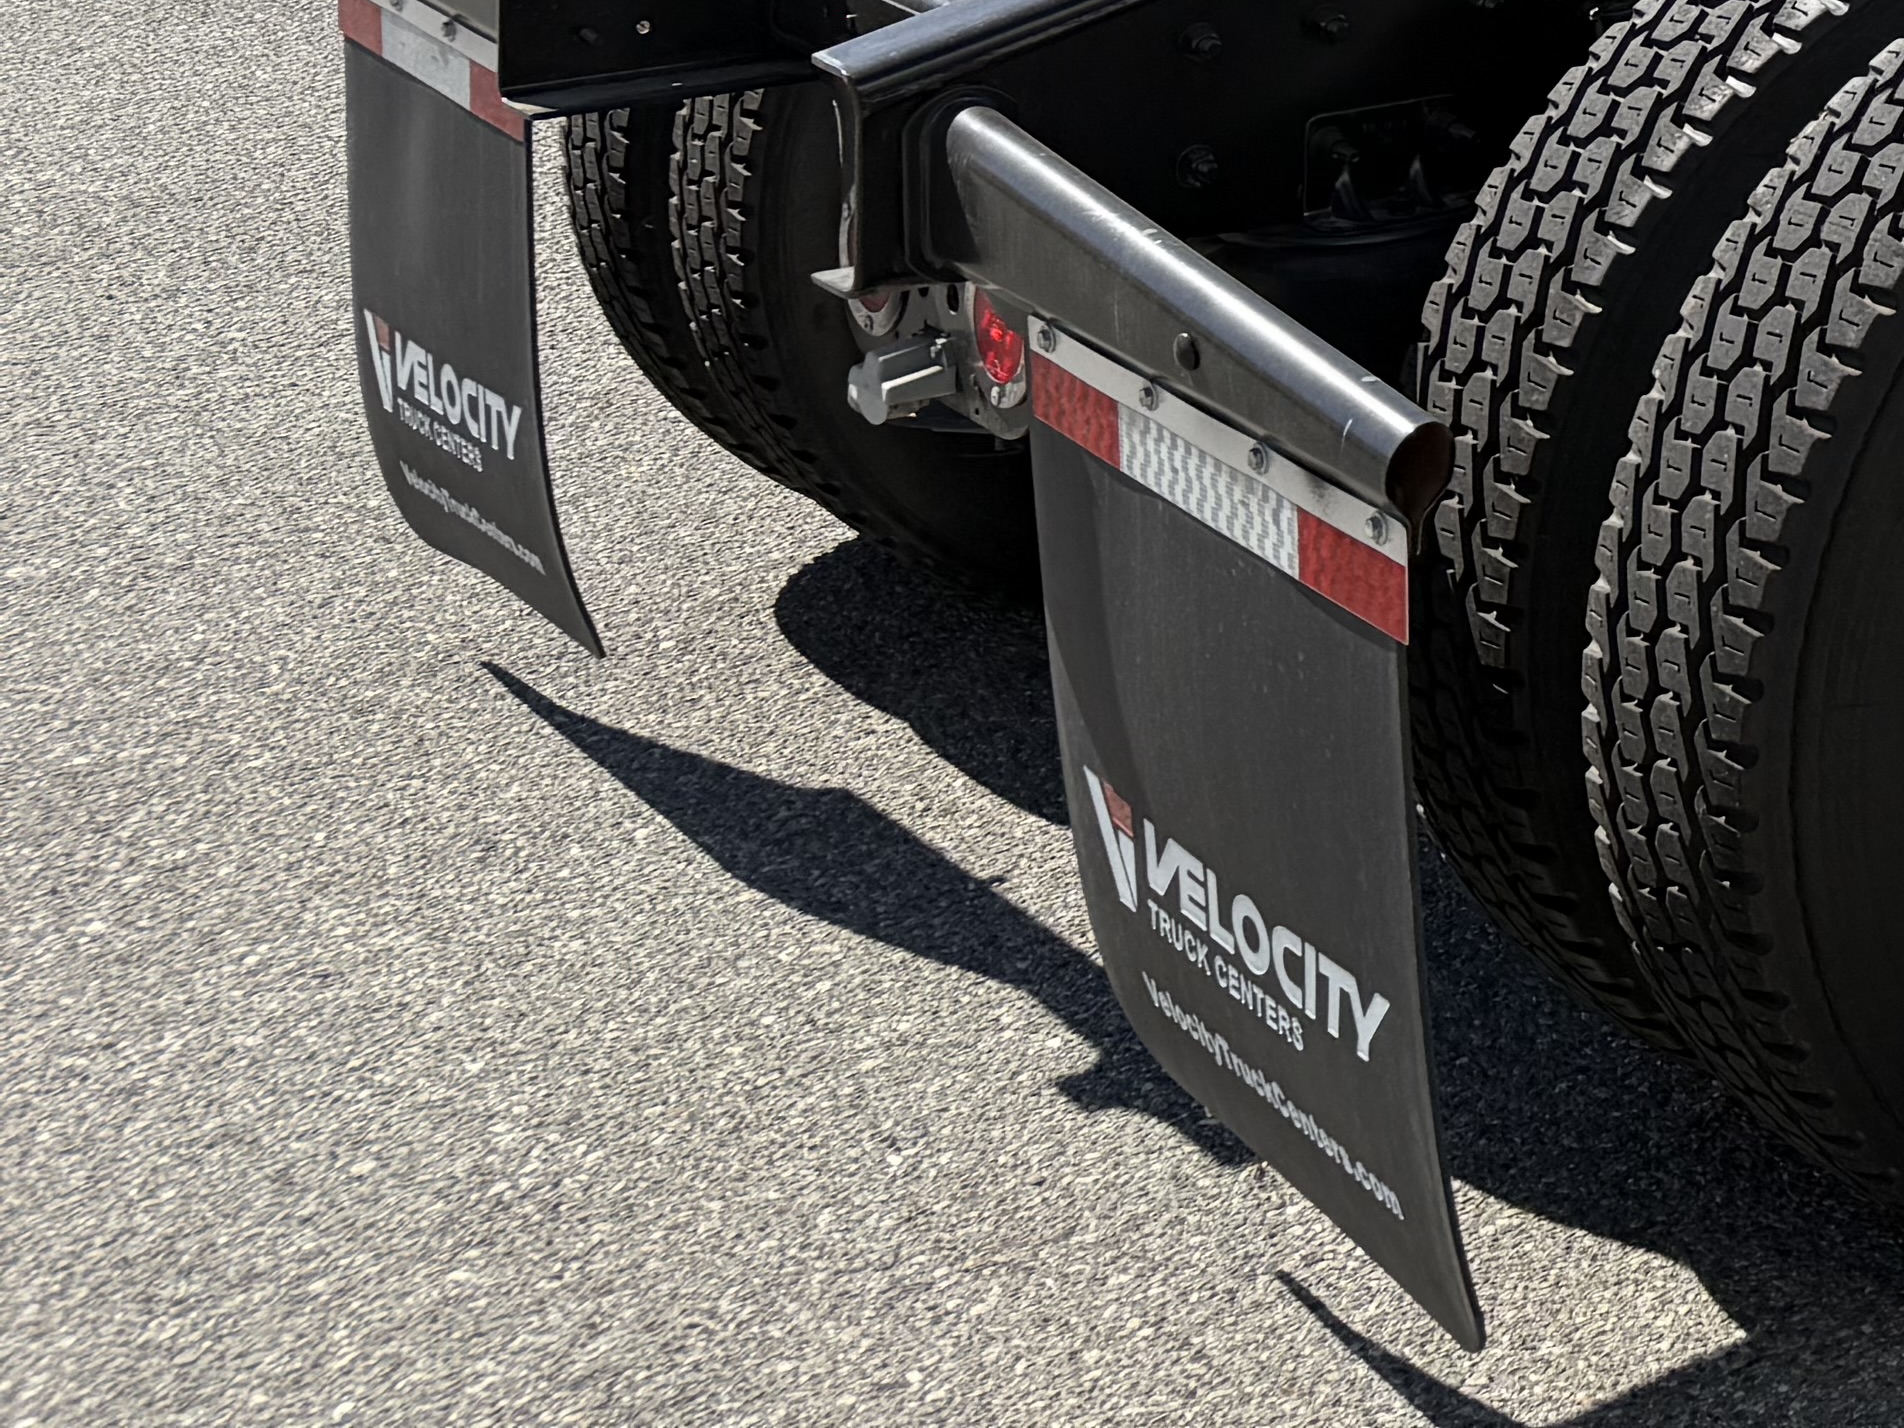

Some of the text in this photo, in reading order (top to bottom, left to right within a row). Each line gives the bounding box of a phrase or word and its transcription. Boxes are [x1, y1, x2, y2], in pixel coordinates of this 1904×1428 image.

[395, 330, 522, 460] VELOCITY
[397, 397, 483, 473] TRUCK CENTERS
[1143, 817, 1391, 1063] VELOCITY
[1147, 899, 1304, 1051] TRUCK CENTERS
[1142, 971, 1405, 1221] VelocityTruckCenters.com
